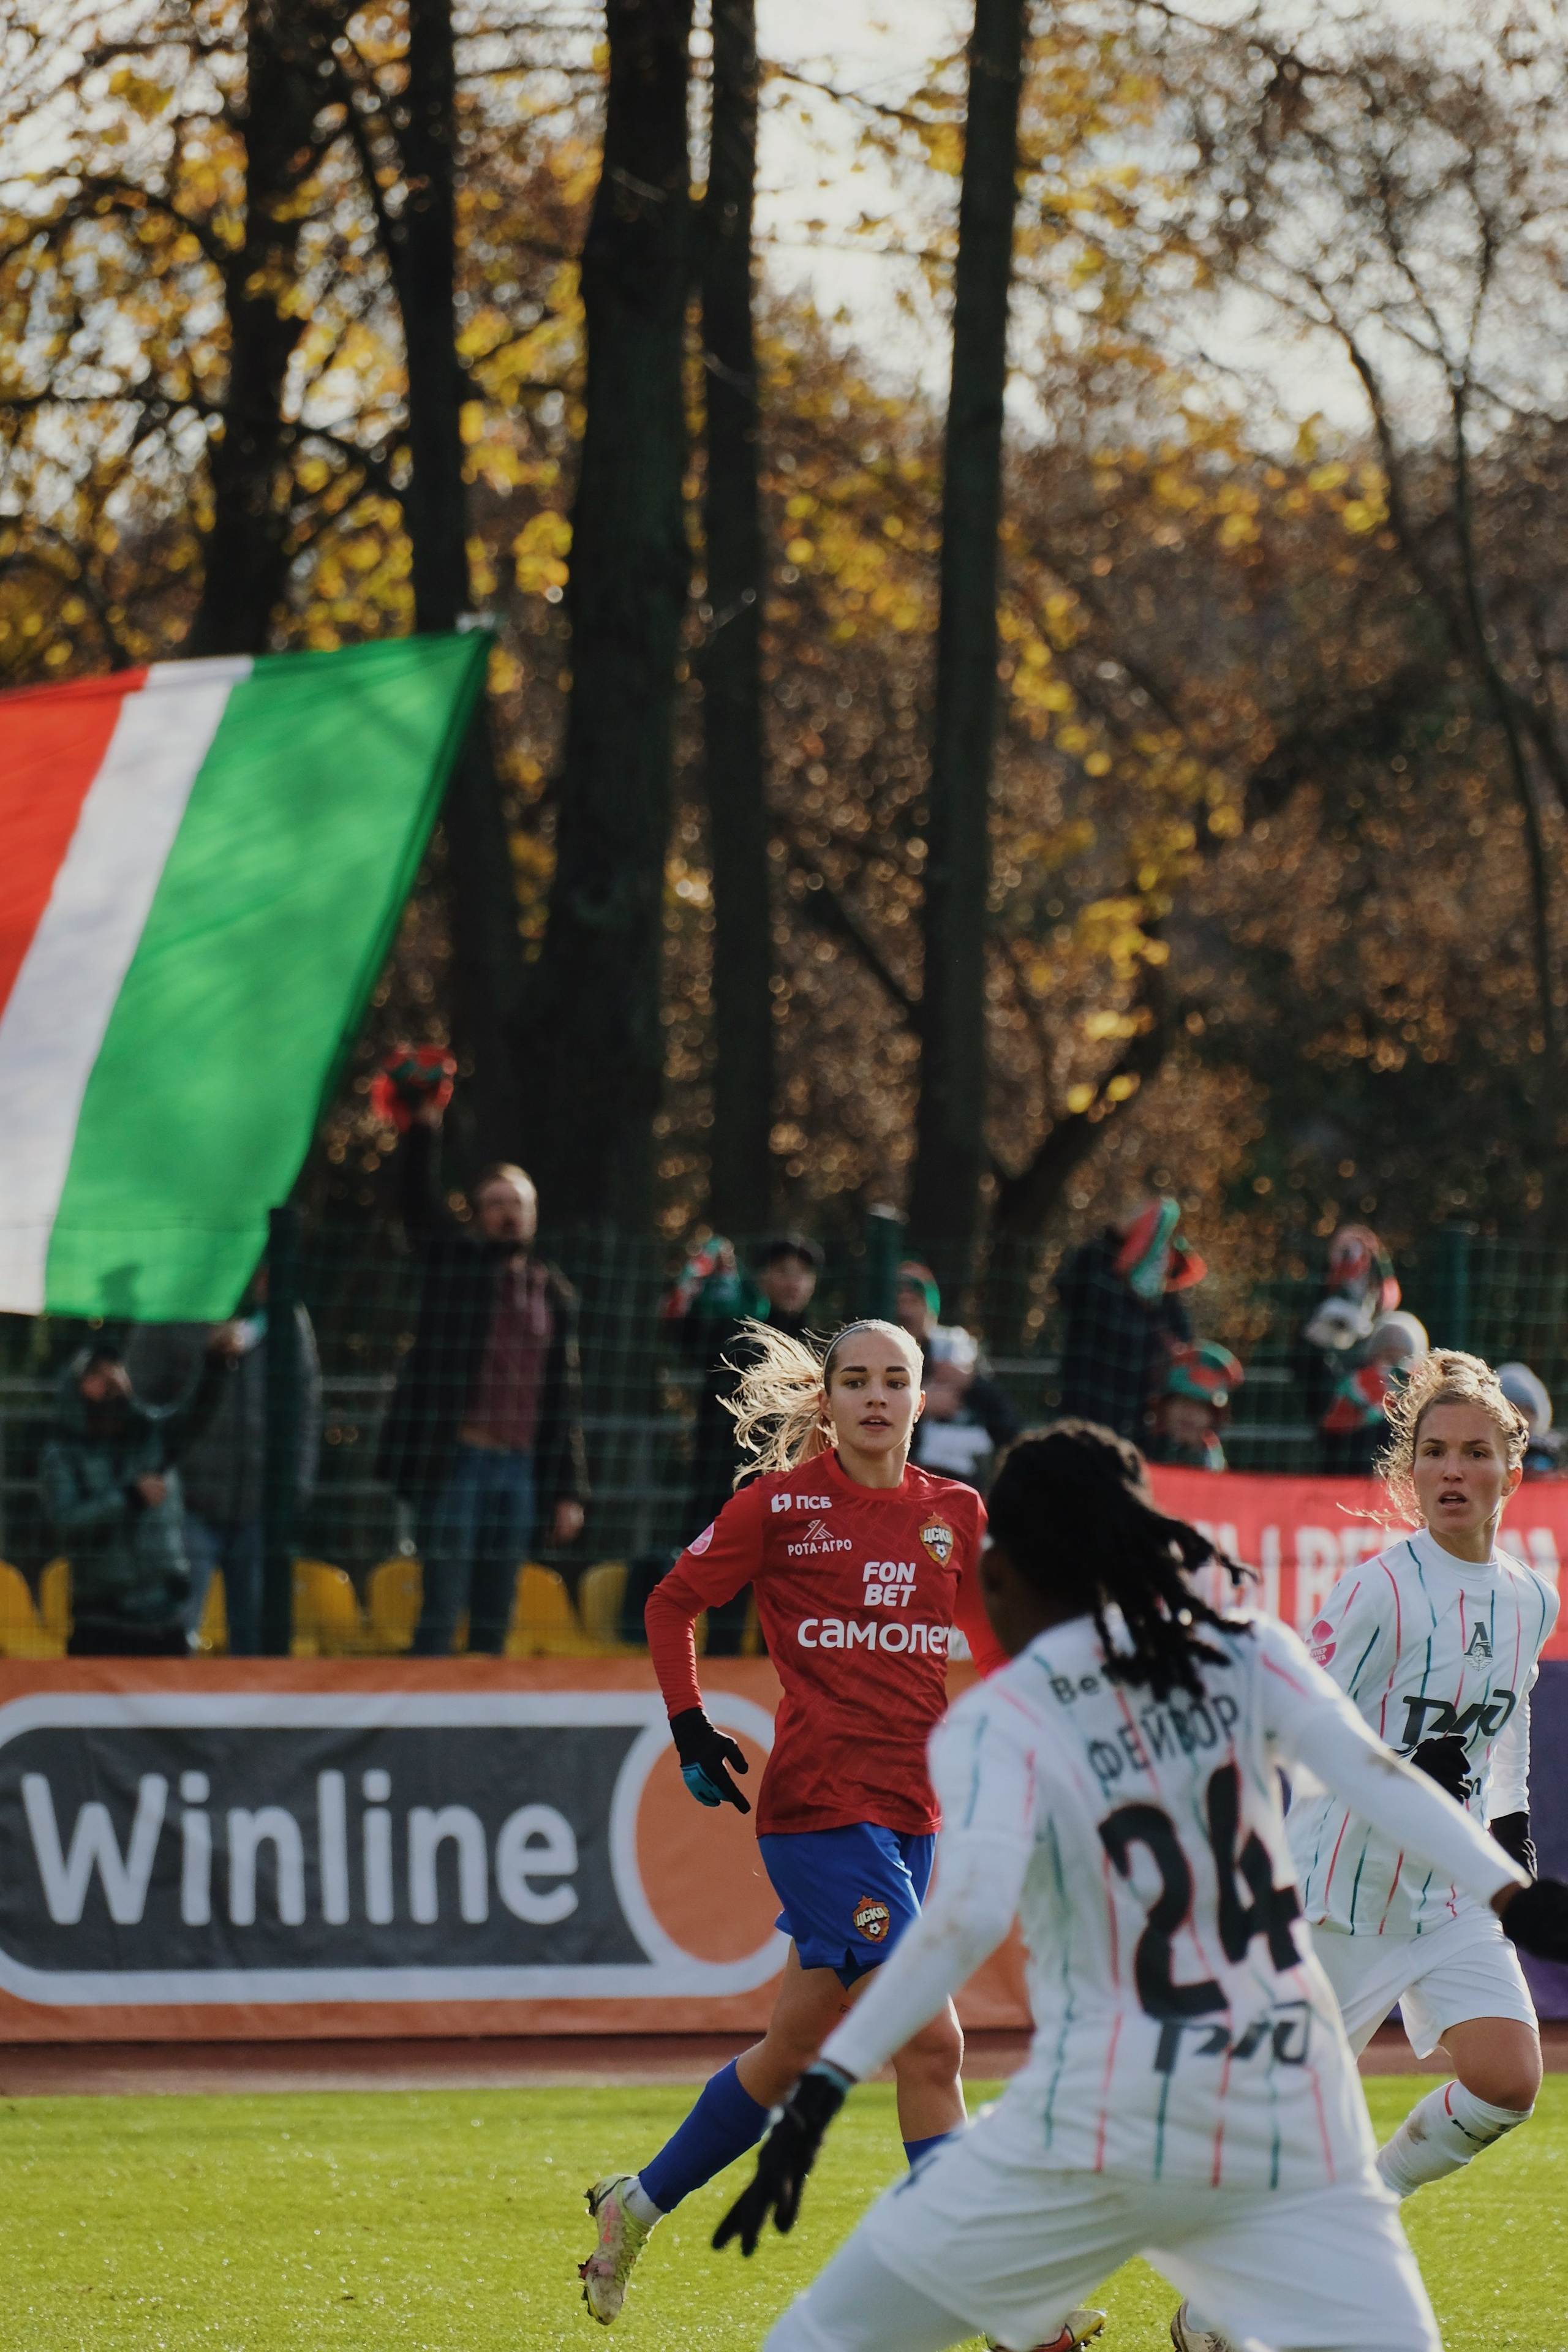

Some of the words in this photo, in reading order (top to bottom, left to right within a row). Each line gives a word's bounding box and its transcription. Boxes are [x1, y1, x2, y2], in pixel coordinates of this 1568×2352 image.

[796, 1496, 832, 1509] ПСБ
[788, 1539, 852, 1556] РОТА-АГРО
[862, 1562, 916, 1583] FON
[864, 1583, 916, 1607] BET
[21, 1770, 579, 1926] Winline
[1099, 1764, 1302, 2017] 24
[856, 1907, 887, 1927] ЦСКА
